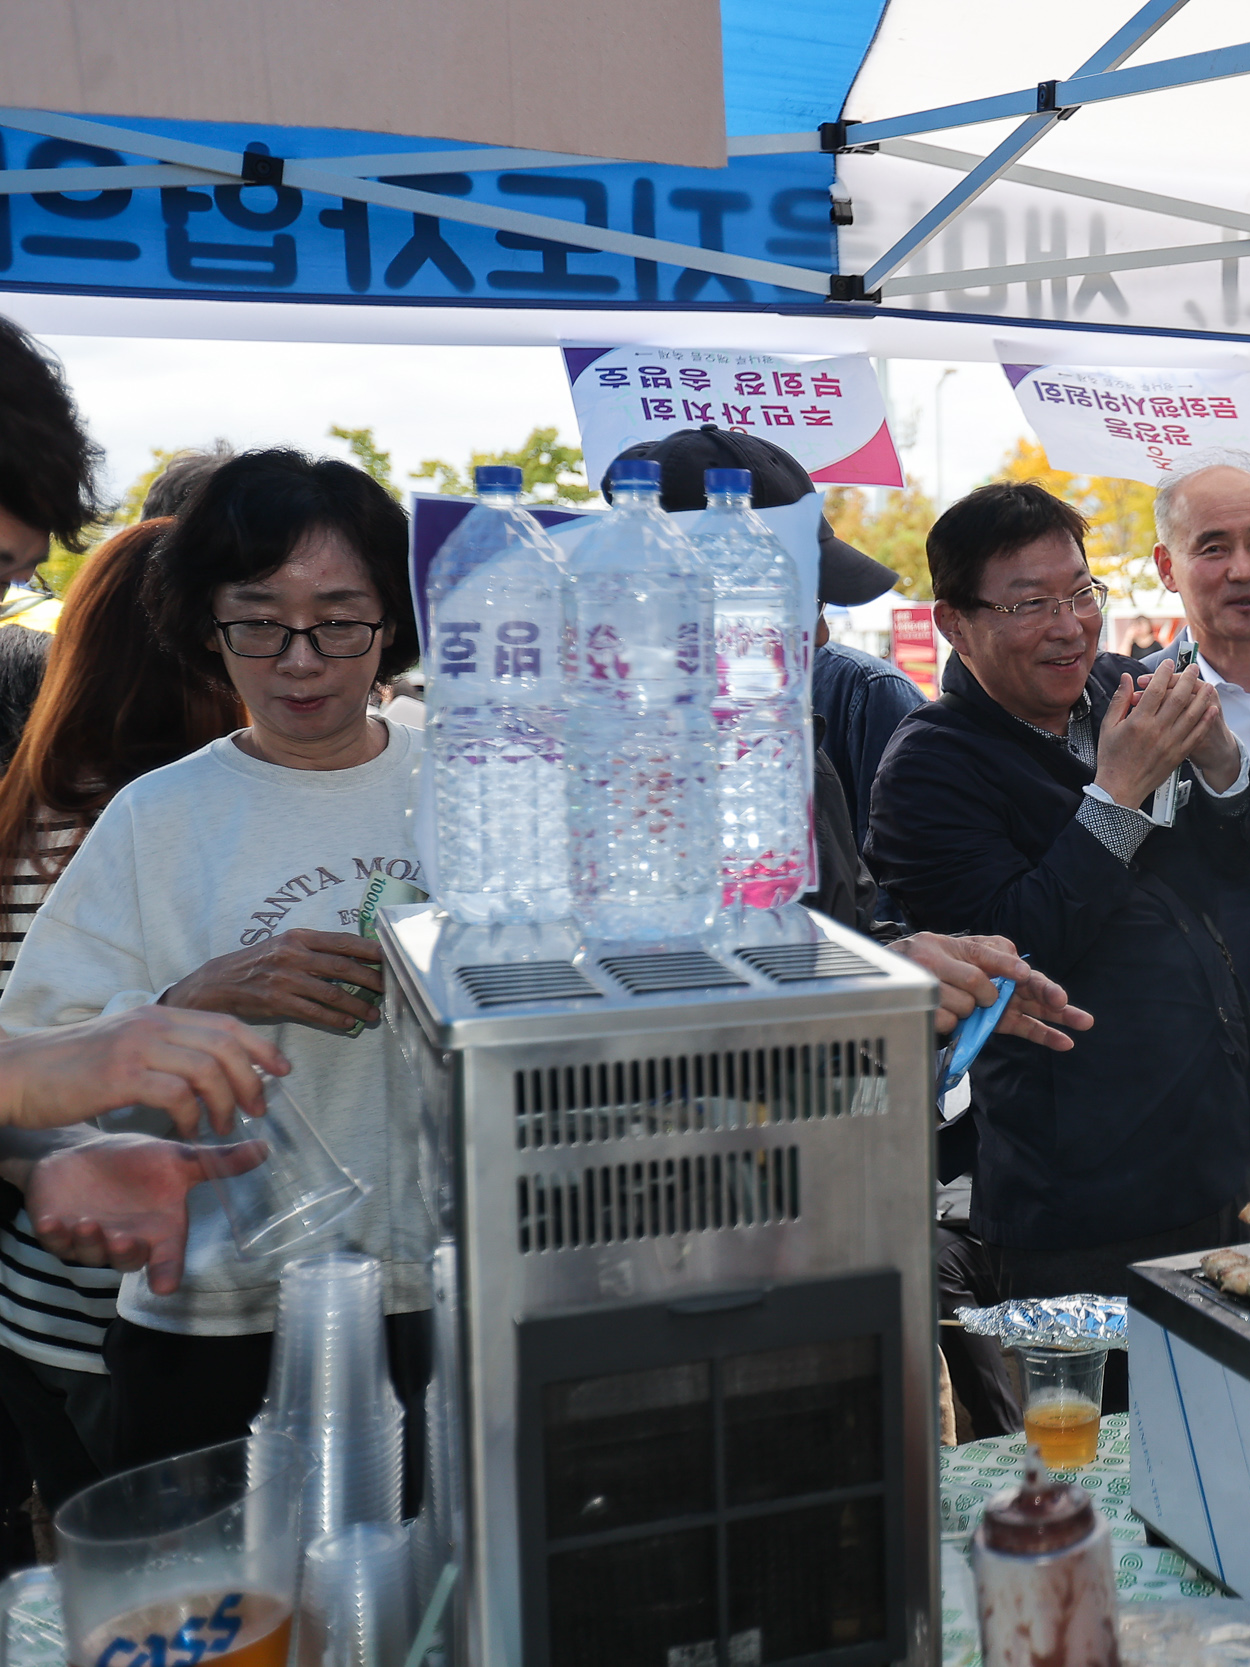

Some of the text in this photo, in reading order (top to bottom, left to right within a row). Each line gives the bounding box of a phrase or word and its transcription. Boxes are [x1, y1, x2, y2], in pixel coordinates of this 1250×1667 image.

[594, 365, 843, 399] 부회장 송병호
[640, 396, 833, 427] 주민자치회
[1032, 379, 1239, 420] 문화행사위원회
[1103, 417, 1192, 447] 광장동
[240, 866, 345, 946] SANTA
[359, 876, 388, 922] 10000
[337, 908, 362, 926] ES
